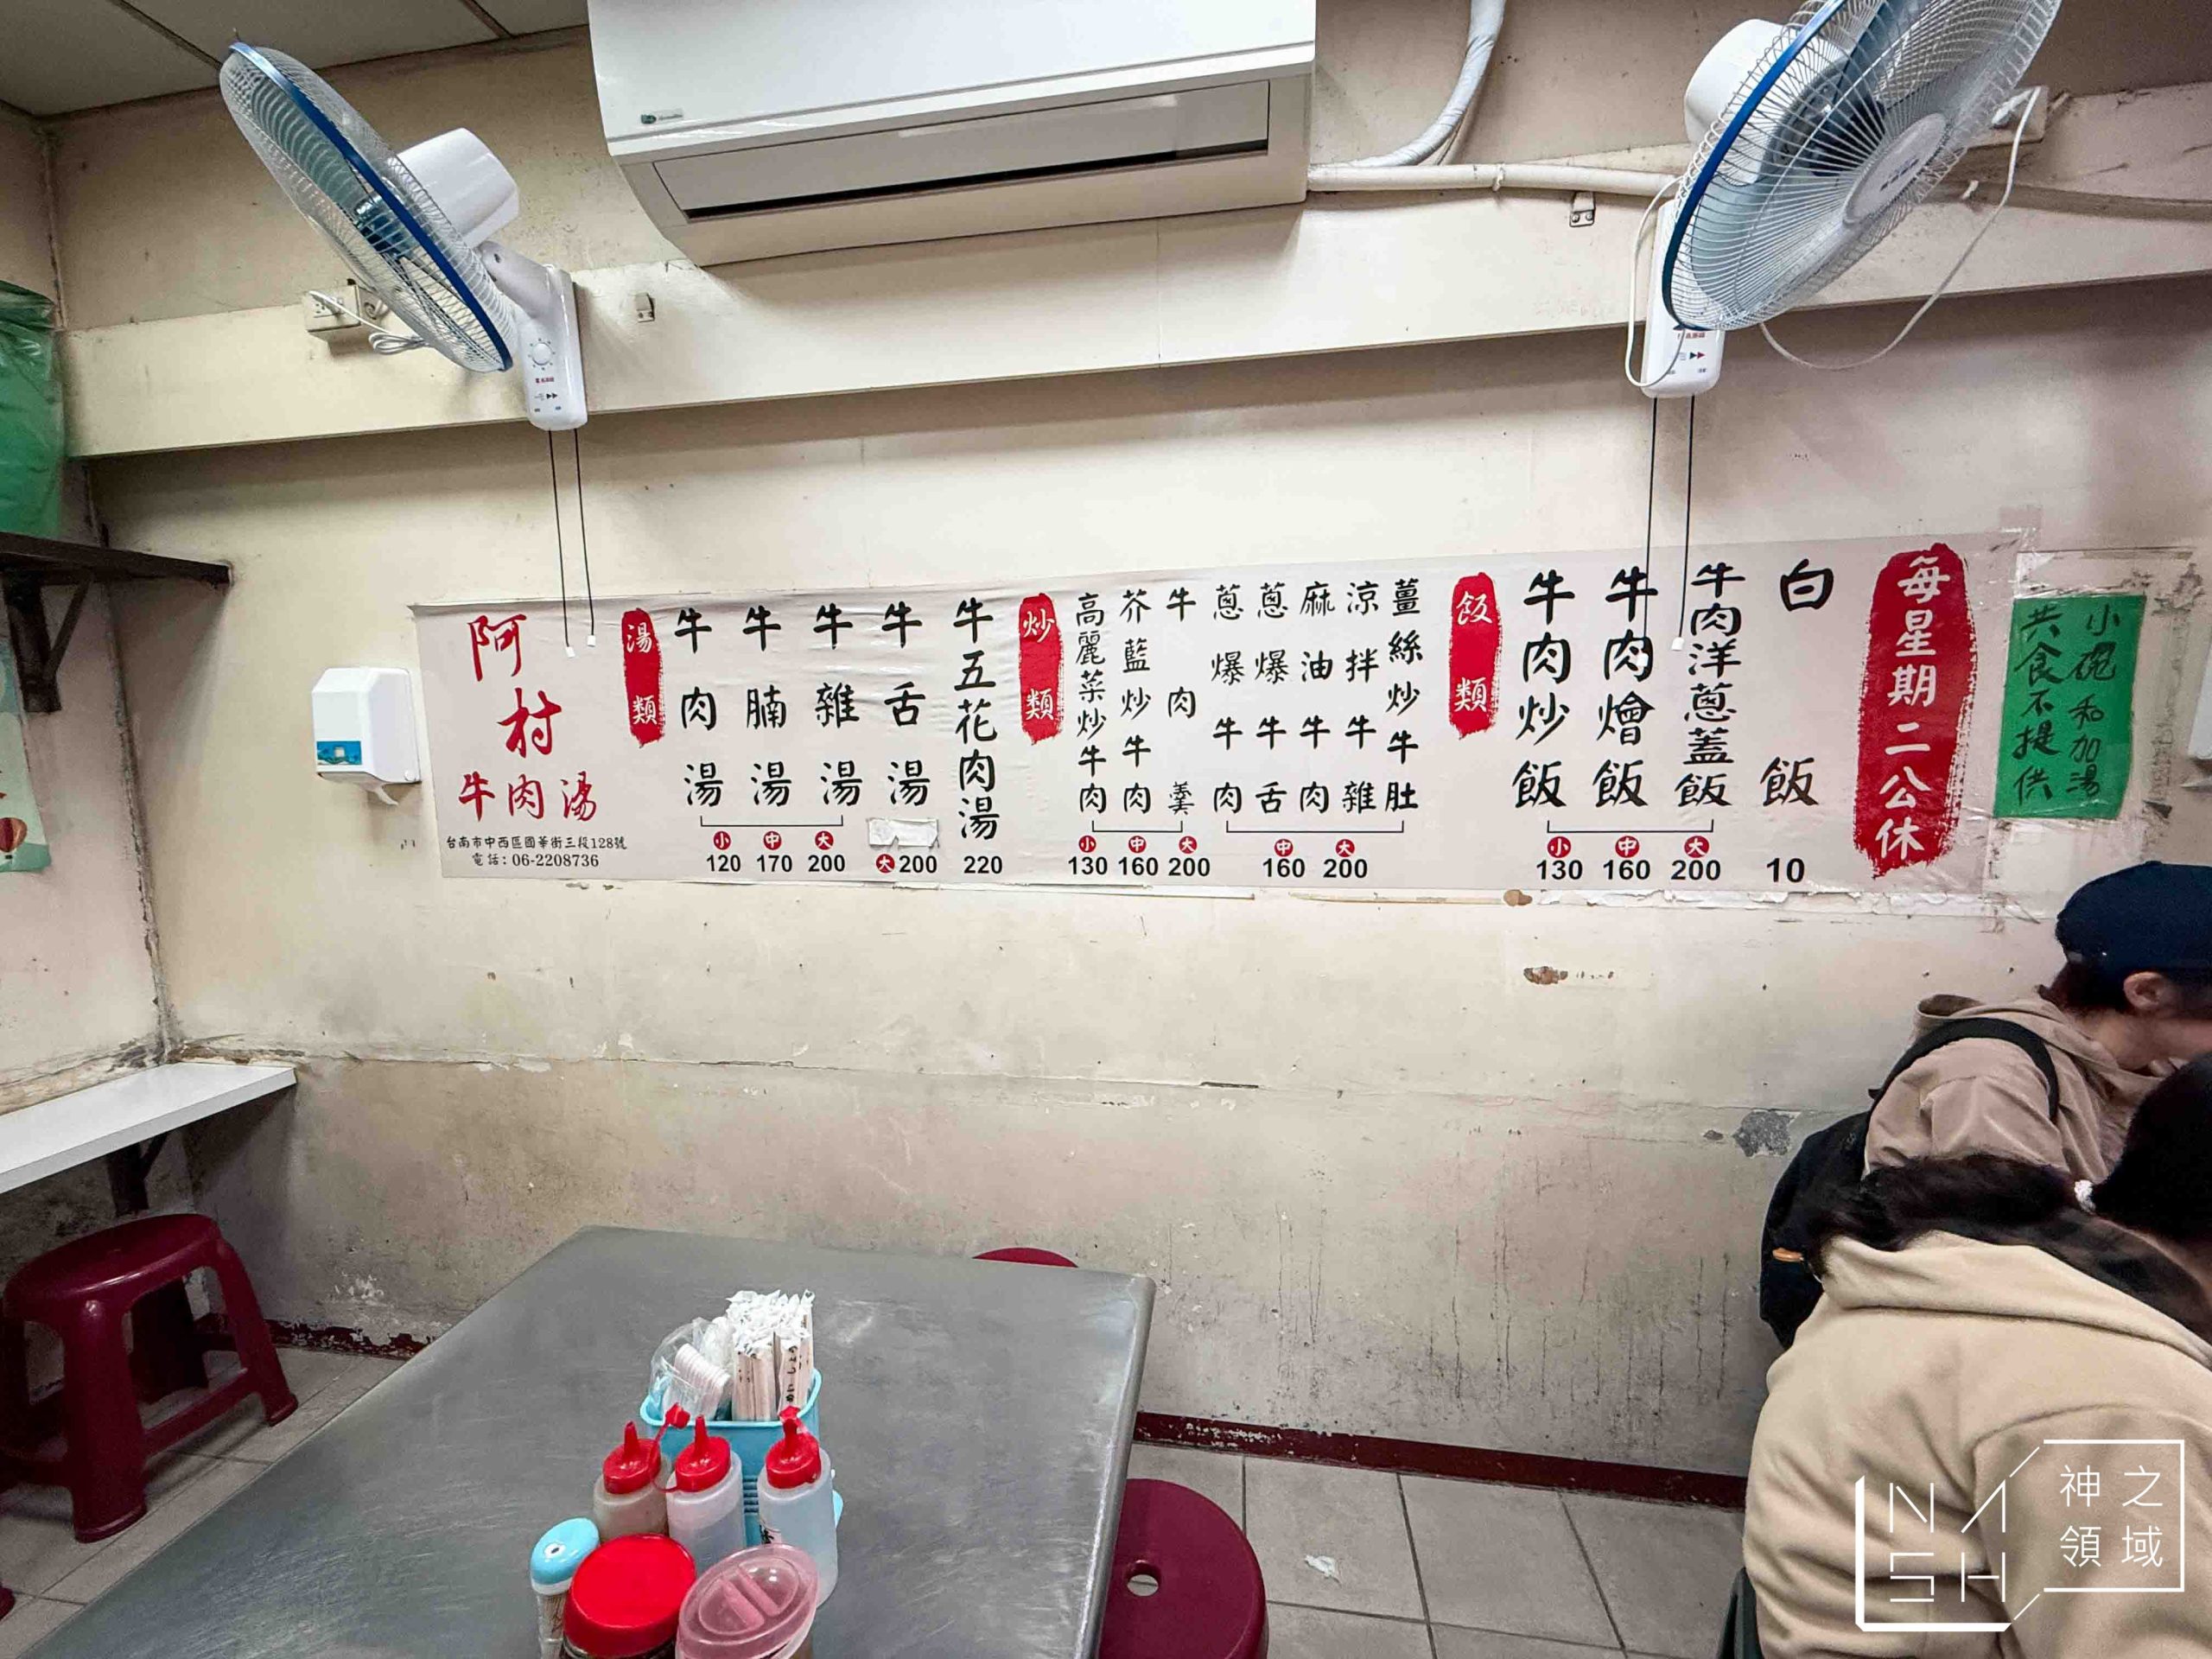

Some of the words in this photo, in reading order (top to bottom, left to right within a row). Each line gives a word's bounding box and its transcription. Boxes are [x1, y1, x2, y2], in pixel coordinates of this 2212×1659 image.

[626, 621, 658, 725] 湯類
[673, 607, 723, 806] 牛肉湯
[743, 605, 791, 806] 牛腩湯
[813, 603, 865, 806] 牛雜湯
[882, 601, 930, 806] 牛舌湯
[954, 597, 999, 840] 牛五花肉湯
[1023, 608, 1055, 721] 炒類
[1077, 593, 1106, 813] 高麗菜炒牛肉
[1121, 589, 1151, 813] 芥藍炒牛肉
[1166, 588, 1196, 814] 牛肉羹
[1212, 584, 1243, 813] 蔥爆牛肉
[1255, 582, 1288, 813] 蔥爆牛舌
[1300, 582, 1335, 813] 麻油牛肉
[1343, 581, 1378, 813] 涼拌牛雜
[1385, 578, 1422, 811] 薑絲炒牛肚
[1454, 591, 1492, 712] 飯類
[1513, 569, 1574, 808] 牛肉炒飯
[1592, 566, 1658, 807] 牛肉燴飯
[1675, 563, 1745, 806] 牛肉洋蔥蓋飯
[1760, 559, 1834, 806] 白飯
[1875, 556, 1950, 860] 每星期二公休
[2012, 605, 2064, 805] 共食不提供
[460, 772, 596, 821] 牛肉湯
[707, 855, 741, 872] 120
[757, 855, 792, 872] 170
[809, 855, 845, 872] 200
[899, 855, 937, 873] 200
[964, 856, 1002, 874] 220
[1069, 856, 1107, 874] 130
[1119, 857, 1158, 875] 160
[1169, 858, 1210, 876] 200
[1263, 858, 1305, 877] 160
[1324, 859, 1367, 878] 200
[1536, 859, 1583, 880] 130
[1604, 860, 1650, 880] 160
[1670, 860, 1721, 880] 200
[1767, 858, 1804, 882] 10
